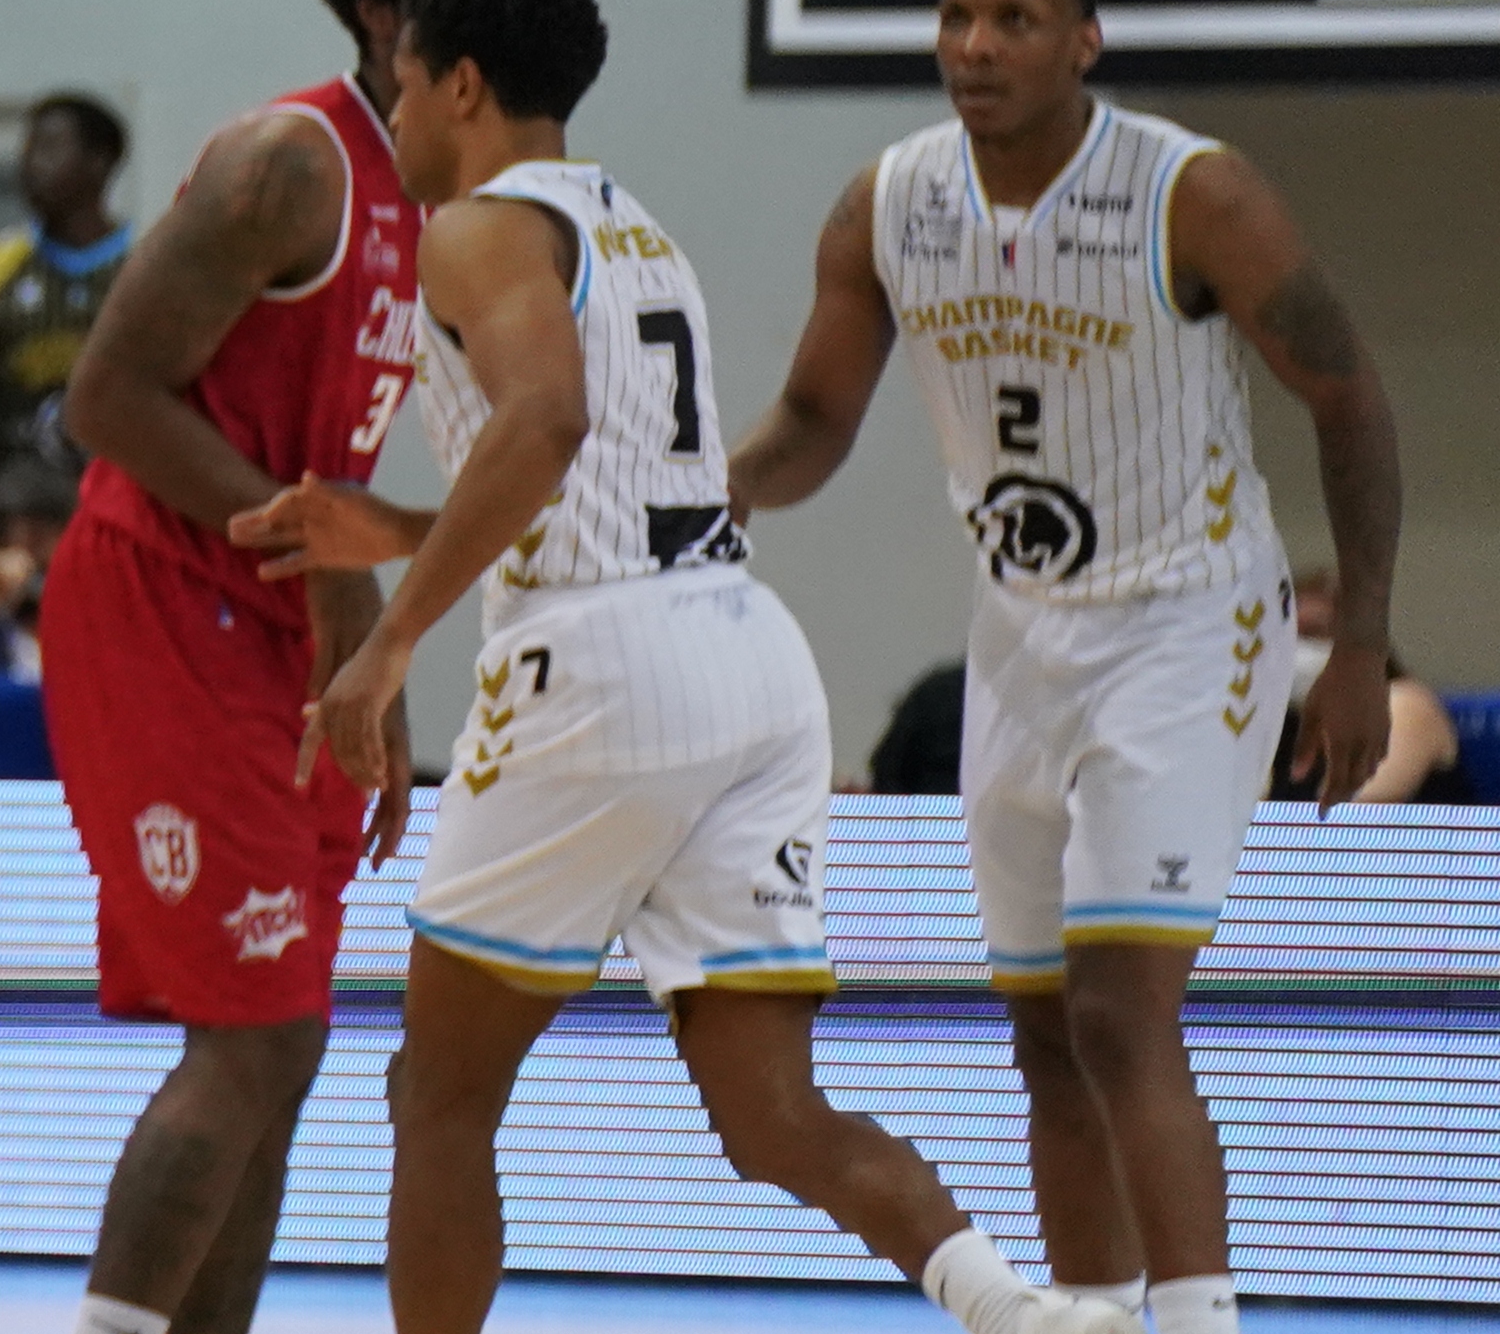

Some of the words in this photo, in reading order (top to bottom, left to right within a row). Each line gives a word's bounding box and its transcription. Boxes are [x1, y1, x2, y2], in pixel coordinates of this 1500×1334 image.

[901, 296, 1135, 351] CHAMPAGNE
[937, 329, 1088, 369] BASKET
[637, 308, 700, 453] 7
[350, 373, 405, 455] 3
[999, 385, 1043, 455] 2
[521, 646, 551, 693] 7
